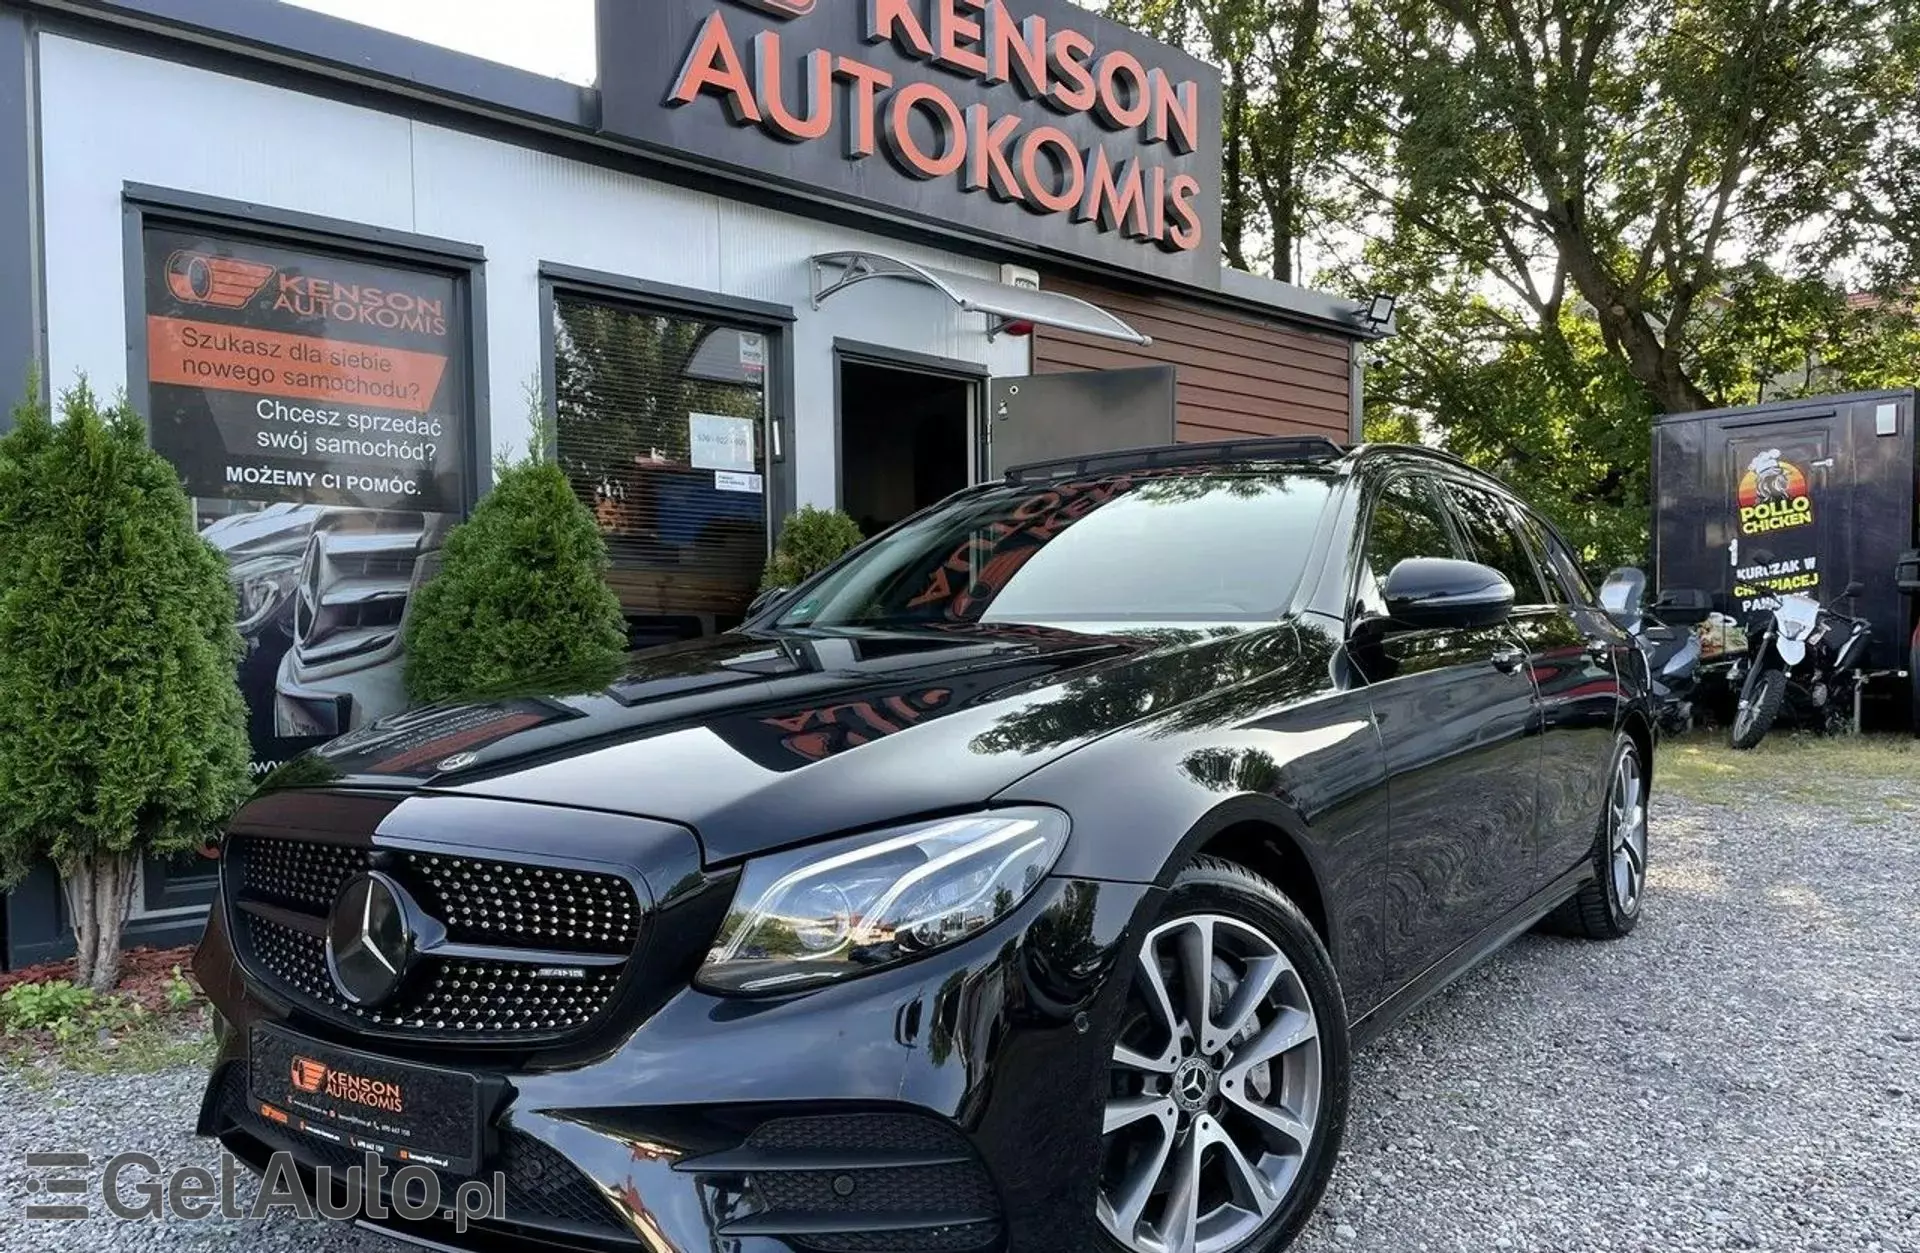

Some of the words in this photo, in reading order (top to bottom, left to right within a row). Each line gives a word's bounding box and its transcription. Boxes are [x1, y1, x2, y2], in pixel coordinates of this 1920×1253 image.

[867, 0, 1198, 154] KENSON
[666, 10, 1202, 252] AUTOKOMIS
[279, 271, 443, 317] KENSON
[273, 295, 447, 336] AUTOKOMIS
[181, 326, 283, 360] Szukasz
[289, 342, 322, 364] dla
[330, 351, 393, 373] siebie
[182, 356, 275, 387] nowego
[283, 370, 421, 401] samochodu?
[256, 399, 341, 428] Chcesz
[347, 410, 442, 438] sprzedać
[256, 429, 309, 455] swój
[315, 433, 437, 462] samochód?
[226, 464, 316, 489] MOŻEMY
[321, 473, 341, 489] CI
[347, 474, 423, 496] POMÓC.
[1740, 495, 1811, 523] POLLO
[1742, 511, 1813, 535] CHICKEN
[1804, 557, 1817, 570] W
[325, 1084, 402, 1113] AUTOKOMIS
[327, 1069, 400, 1098] KENSON
